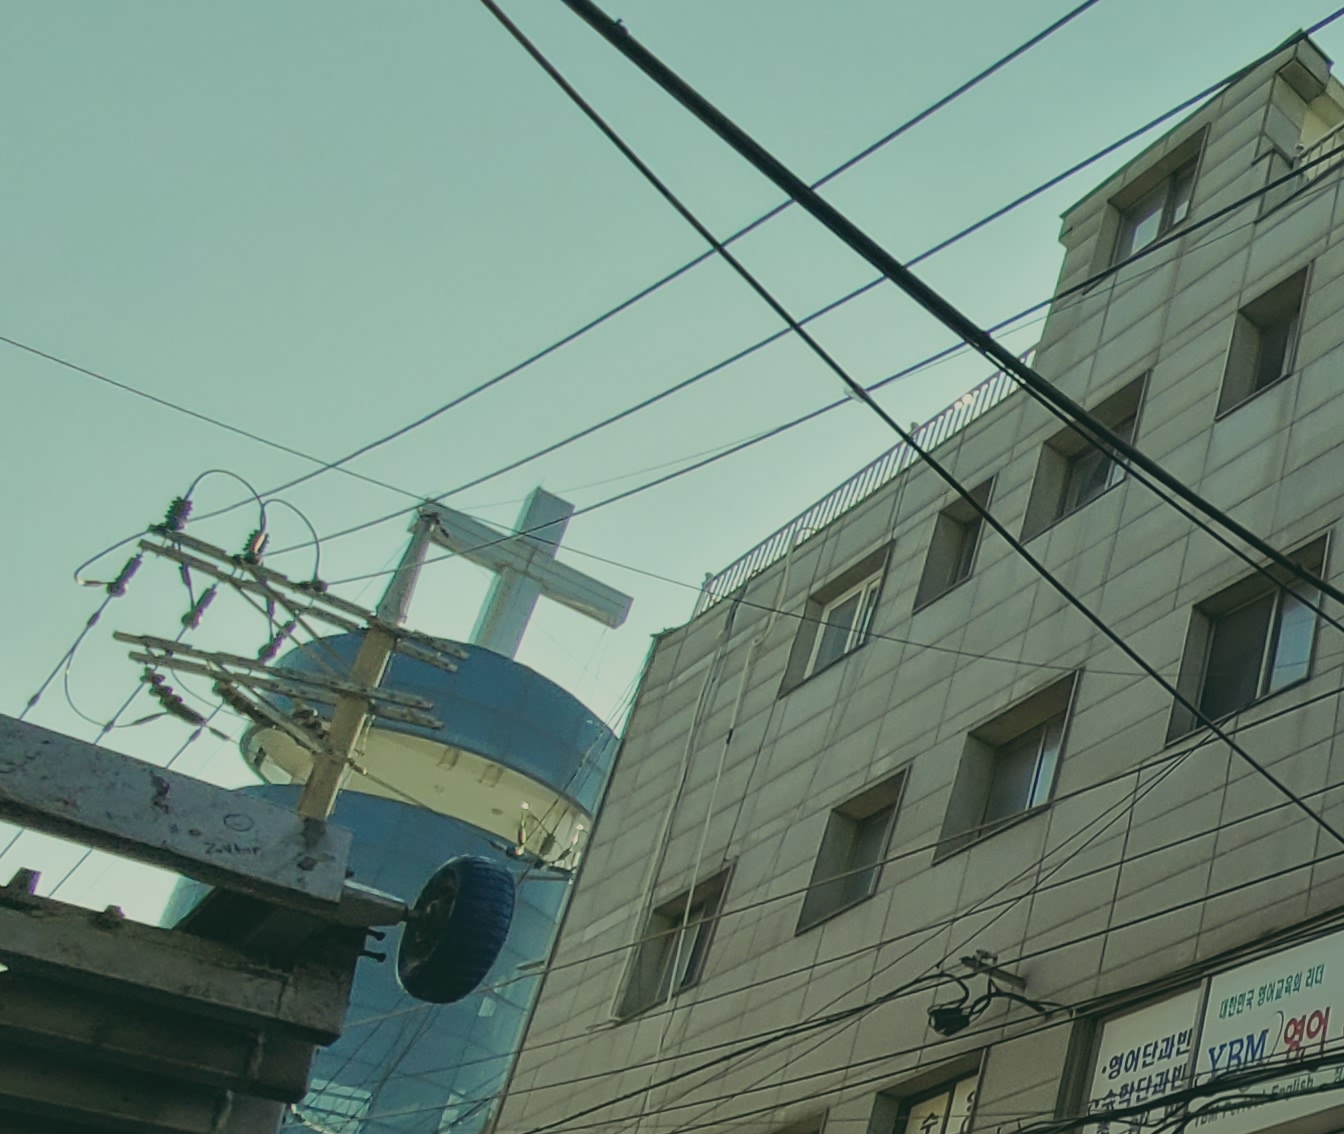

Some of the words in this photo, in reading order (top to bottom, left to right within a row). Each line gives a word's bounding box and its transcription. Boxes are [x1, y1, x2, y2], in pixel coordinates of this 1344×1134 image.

[1218, 987, 1255, 1021] 대한민국
[1257, 974, 1302, 1008] 영어교육의
[1305, 963, 1325, 989] 리더
[1208, 1027, 1269, 1076] YBM
